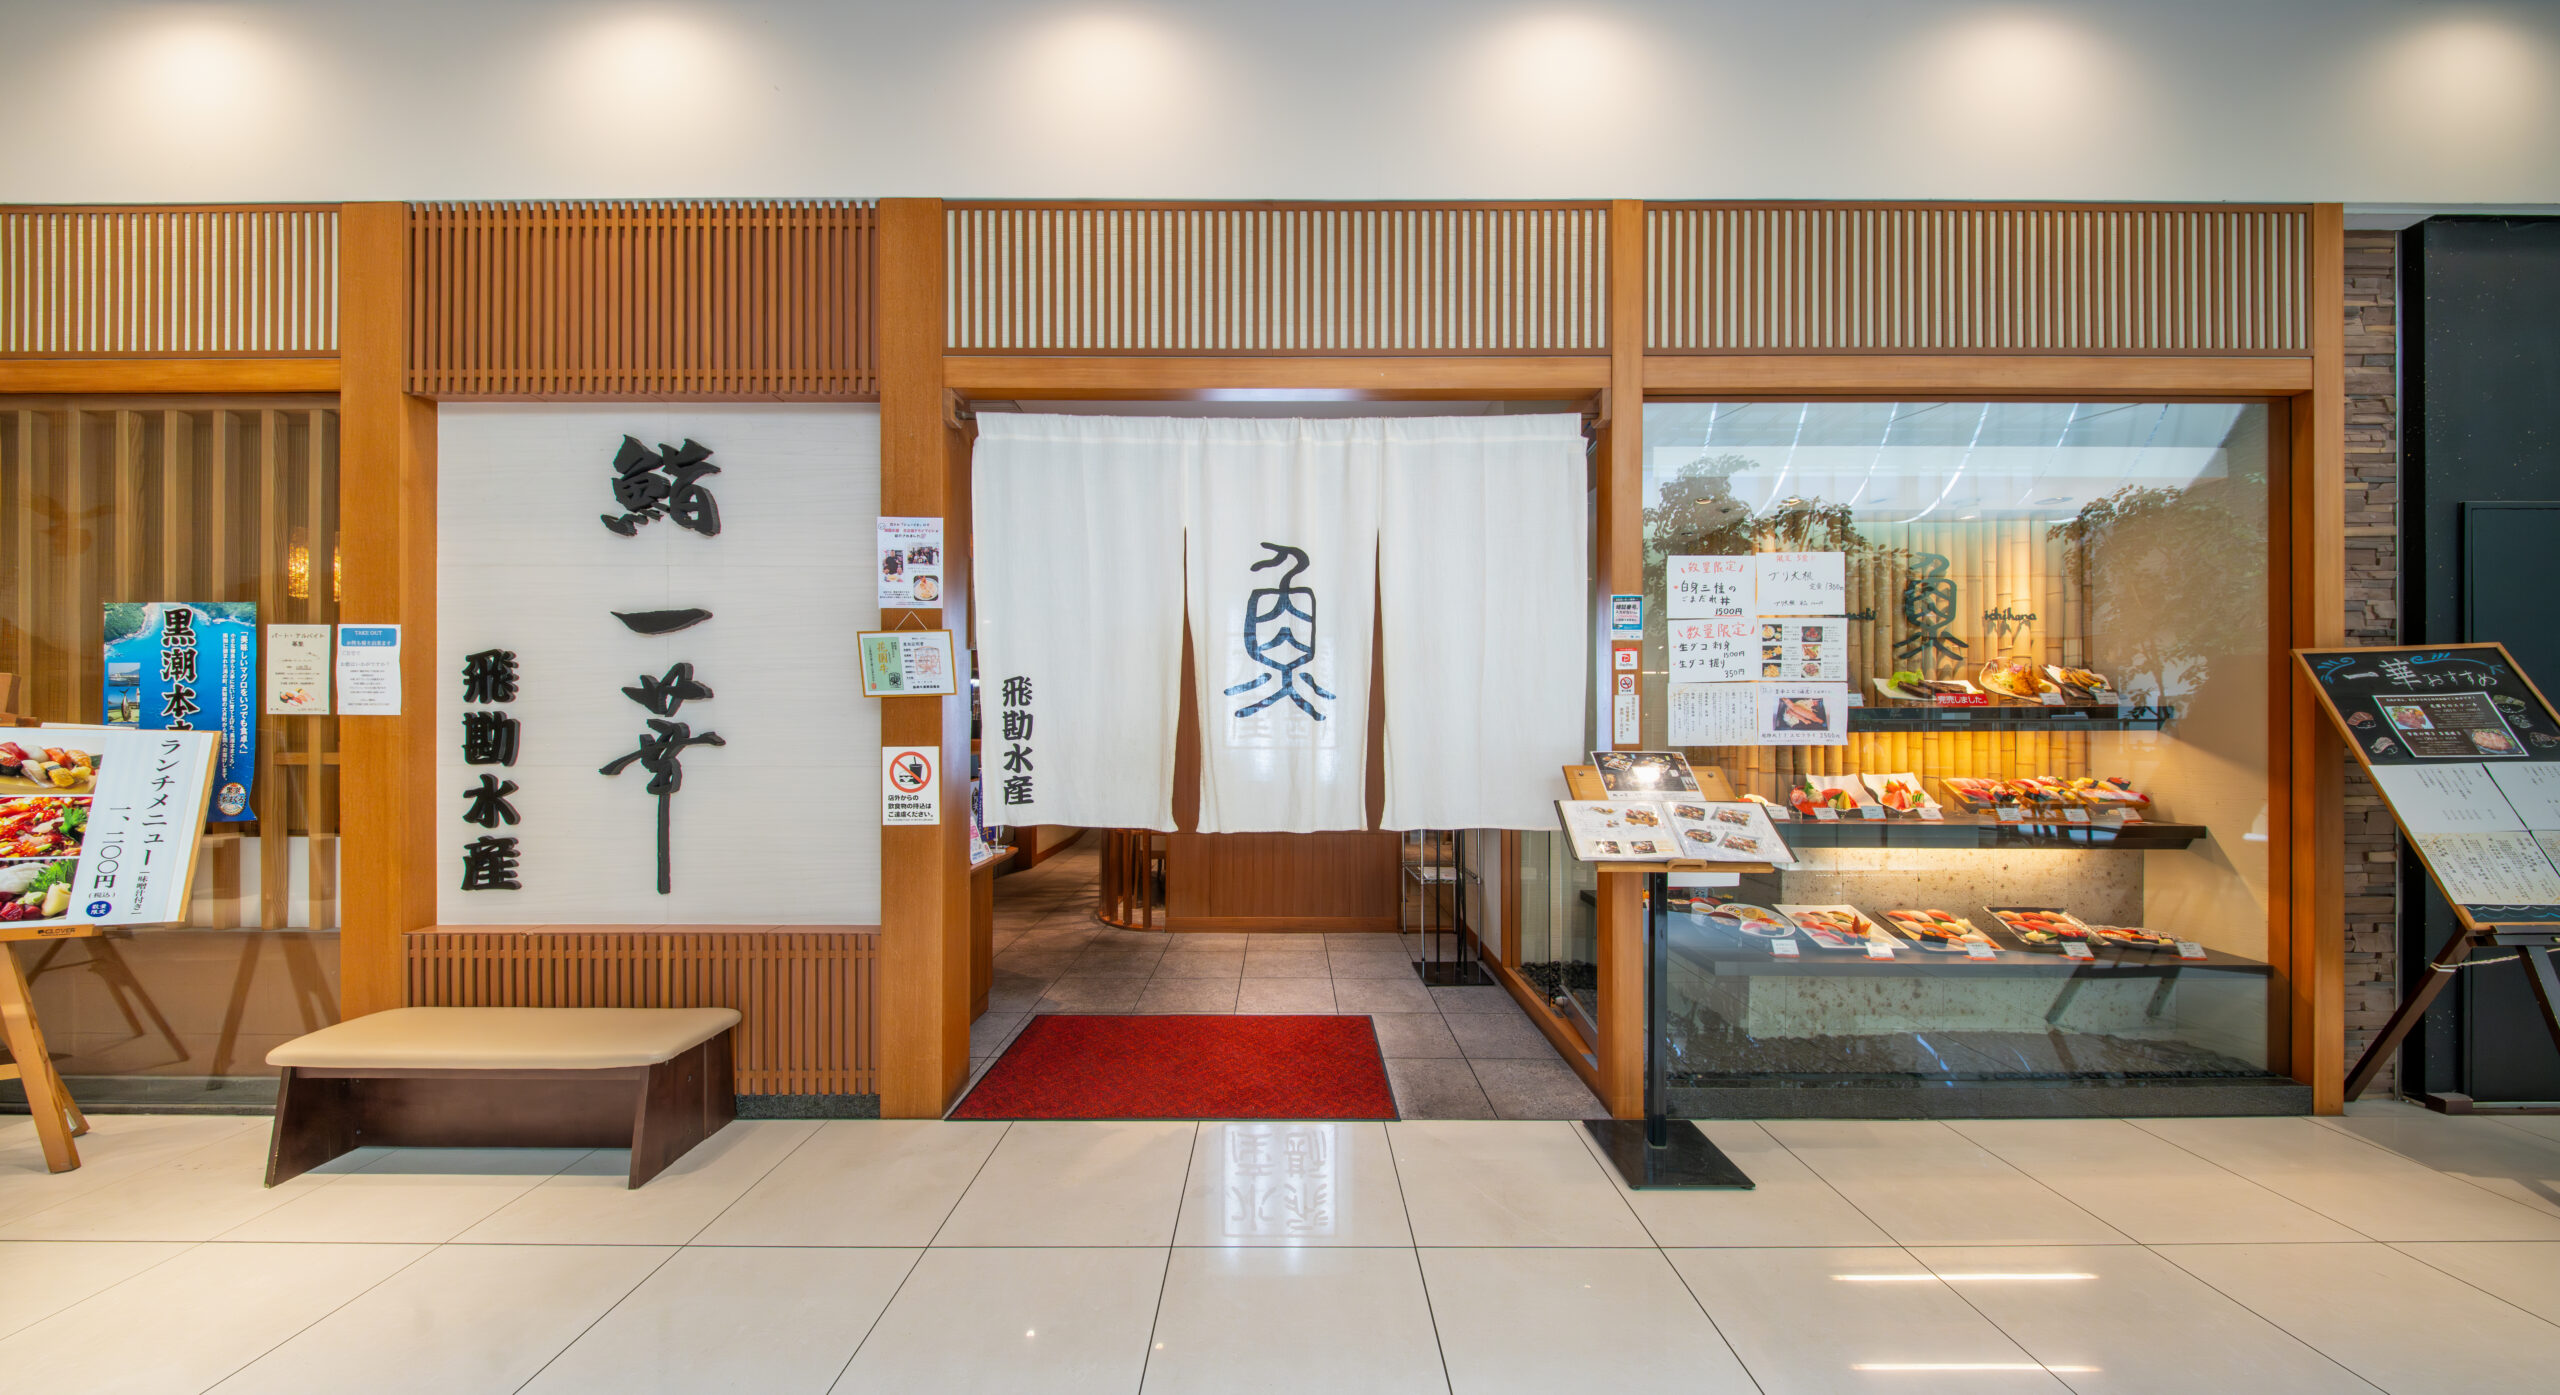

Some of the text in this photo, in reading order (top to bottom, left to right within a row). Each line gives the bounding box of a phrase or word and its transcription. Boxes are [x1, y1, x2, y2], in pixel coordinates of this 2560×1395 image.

[1688, 561, 1738, 574] 数量限定
[1681, 580, 1737, 595] 白身三種の
[1715, 608, 1743, 616] 1500円
[1984, 607, 2038, 622] ichihana
[1686, 621, 1748, 640] 数量限定
[1724, 669, 1745, 679] 350円
[1937, 695, 1988, 705] 完売しました。
[1002, 676, 1034, 806] 飛勘水産
[461, 648, 523, 891] 飛勘水産
[142, 740, 181, 866] ランチメニュー
